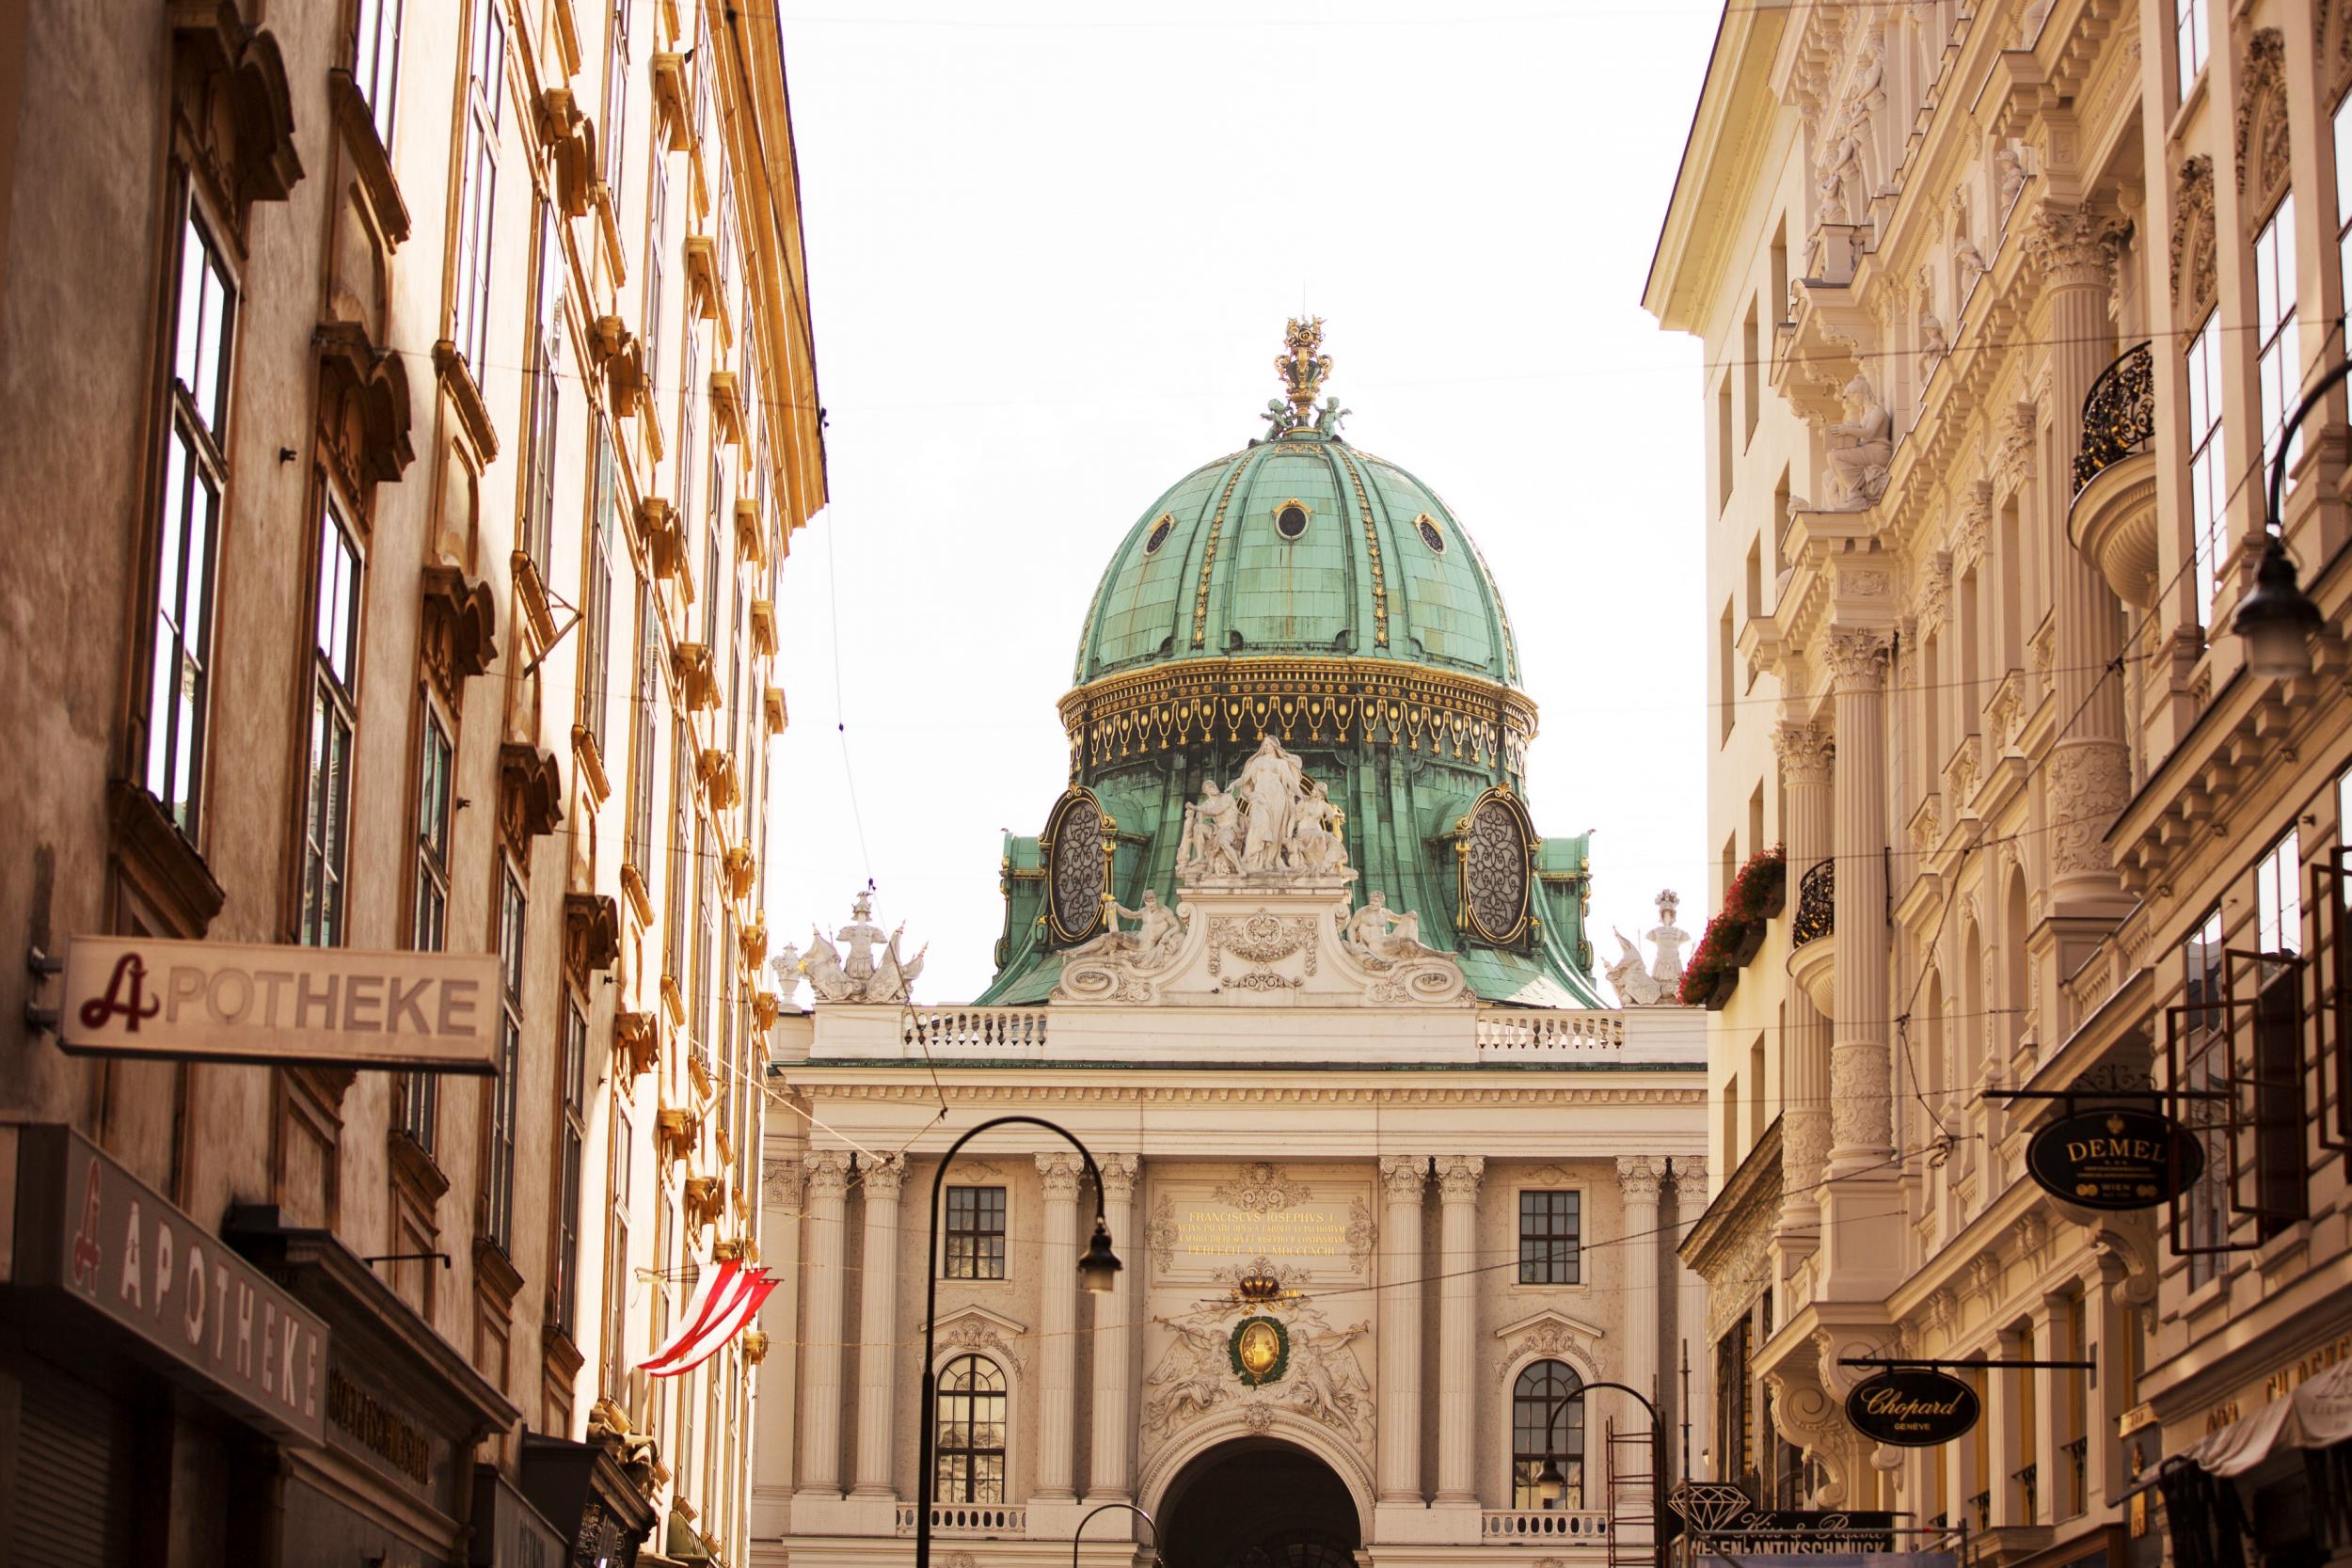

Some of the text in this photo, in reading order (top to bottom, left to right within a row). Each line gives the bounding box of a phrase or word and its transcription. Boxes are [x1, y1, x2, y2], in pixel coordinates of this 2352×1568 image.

[80, 951, 479, 1036] APOTHEKE
[2066, 1138, 2166, 1164] DEMEL
[1188, 1212, 1261, 1222] FRANCISCVS
[1267, 1212, 1325, 1223] IOSEPHVS
[121, 1199, 318, 1420] APOTHEKE
[1860, 1386, 1964, 1421] Chopard
